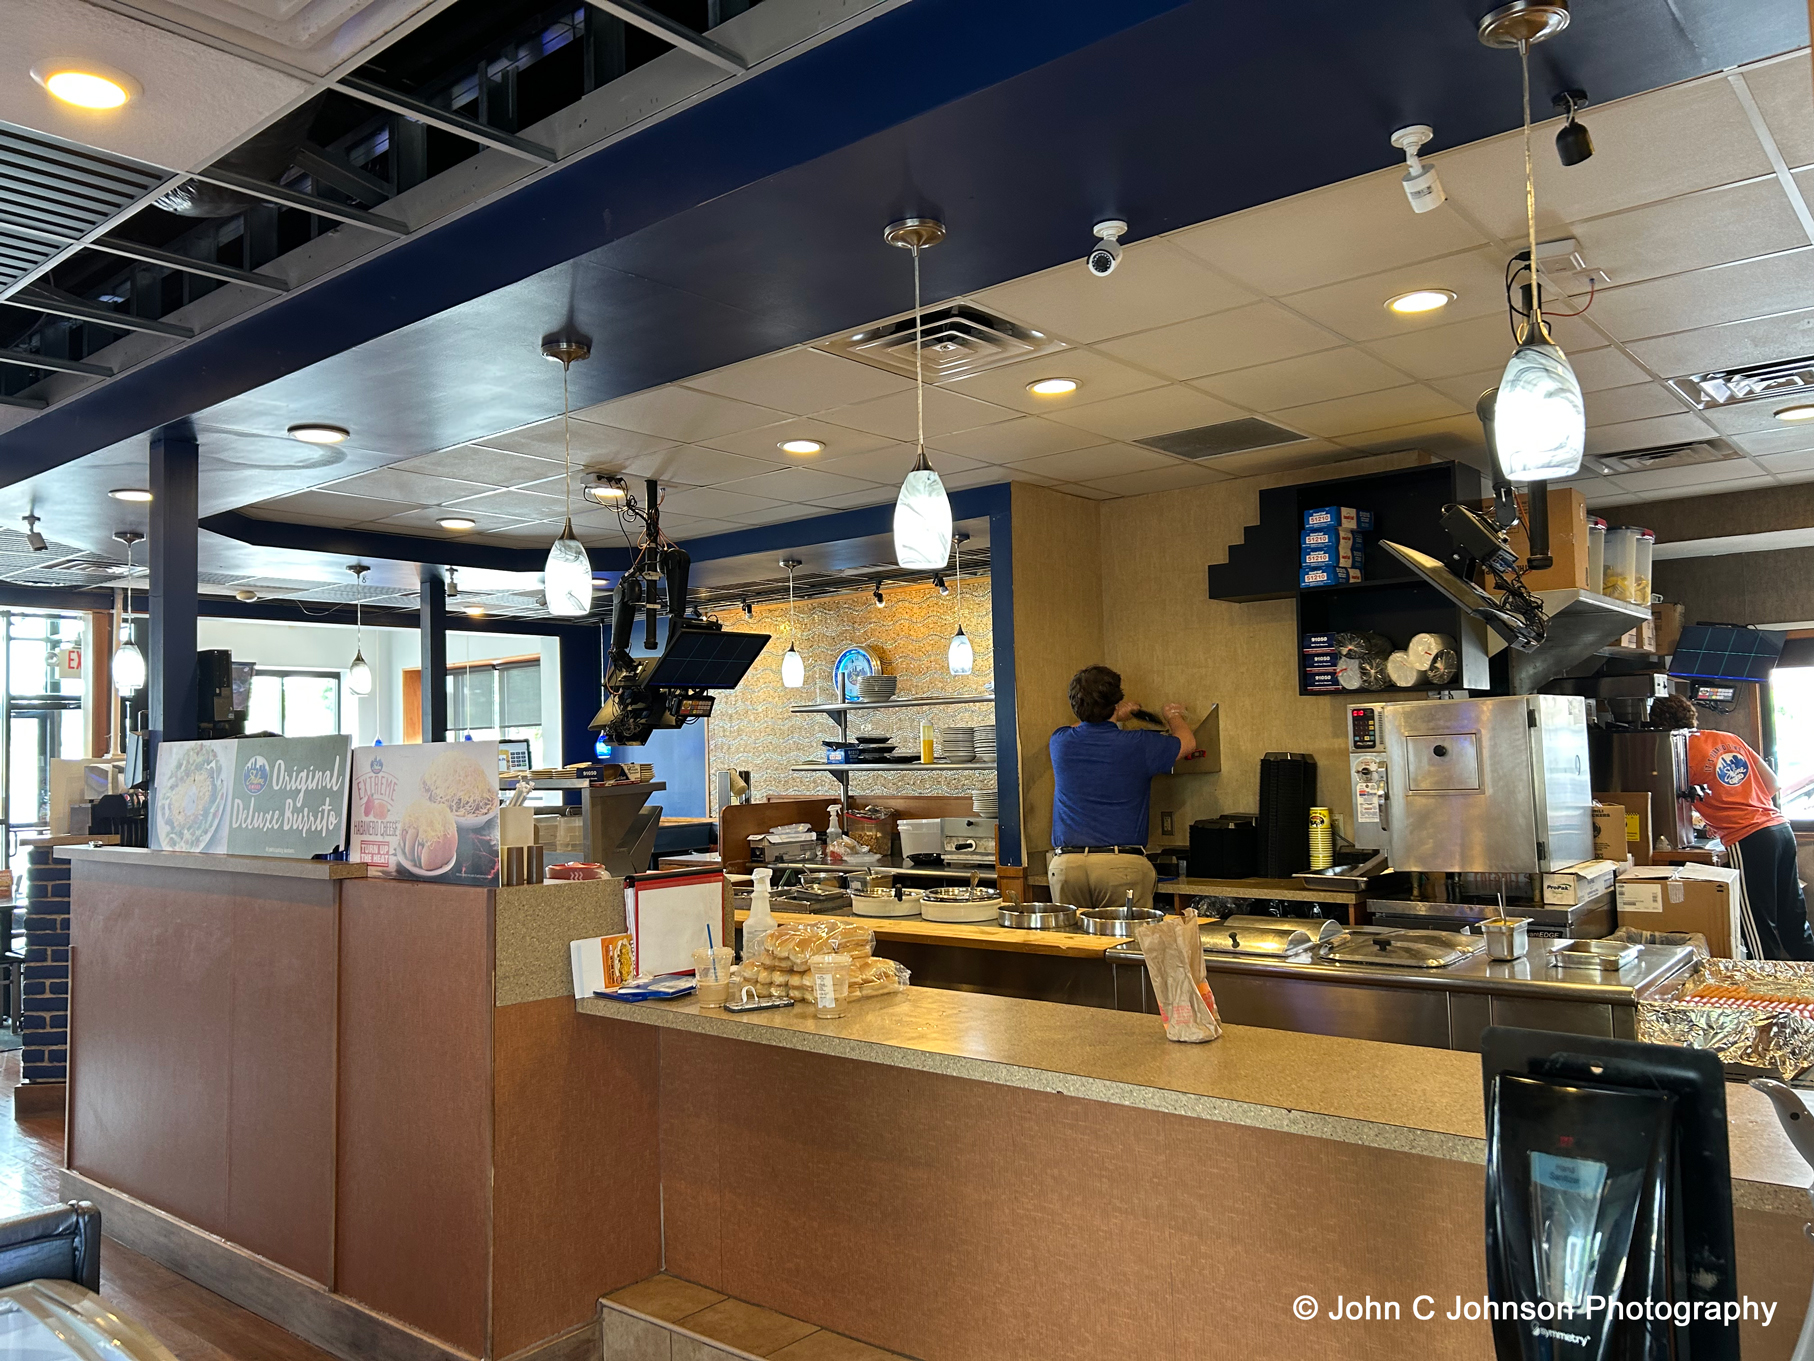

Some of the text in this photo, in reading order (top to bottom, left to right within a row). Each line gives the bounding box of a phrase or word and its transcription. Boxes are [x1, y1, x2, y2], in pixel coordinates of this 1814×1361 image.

[1310, 515, 1330, 523] 51210
[68, 650, 82, 670] EX
[272, 755, 343, 807] Original
[356, 775, 398, 802] EXTREME
[232, 797, 340, 837] Deluxe Burrito
[353, 820, 398, 839] HABANERO CHEESE
[361, 844, 389, 853] TURN UP
[361, 853, 389, 863] THE HEAT
